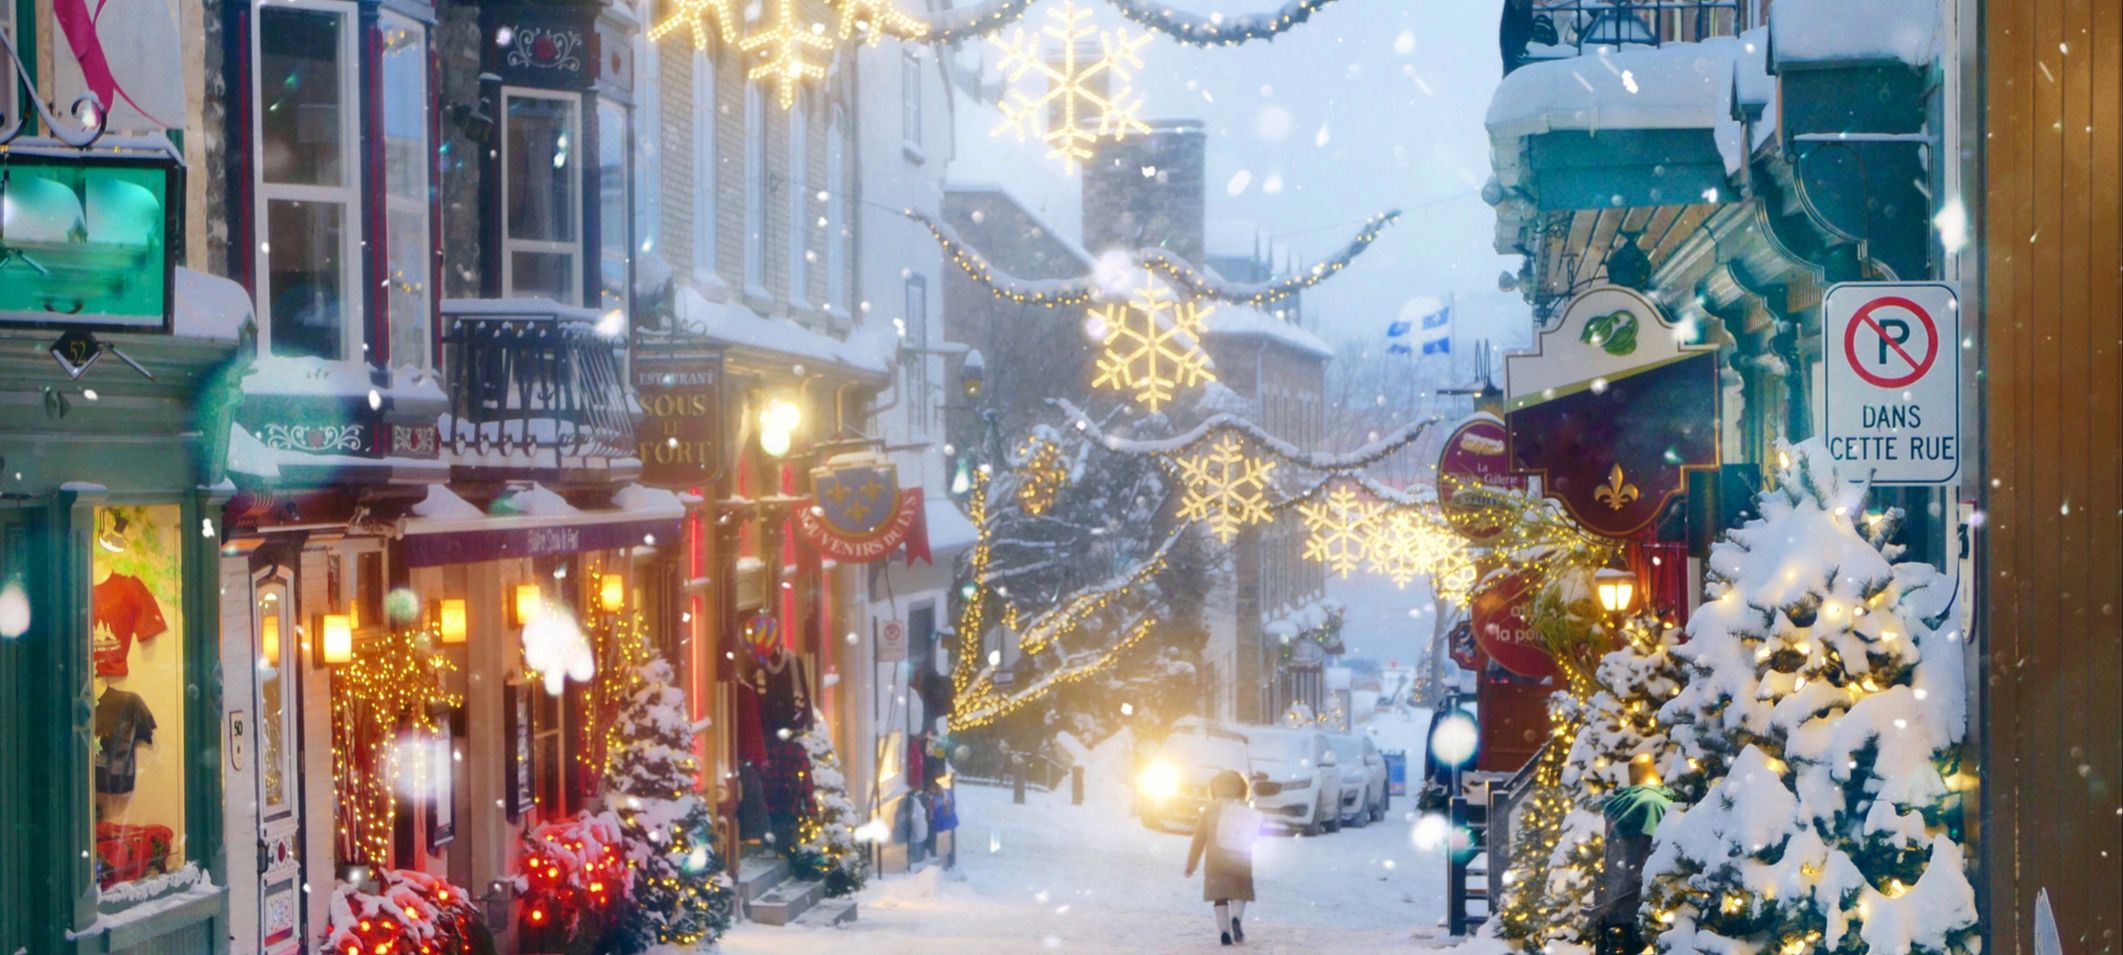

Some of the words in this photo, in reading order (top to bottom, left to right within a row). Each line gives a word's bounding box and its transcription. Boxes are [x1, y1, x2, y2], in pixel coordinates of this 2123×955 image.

[70, 341, 87, 364] 52
[639, 372, 713, 385] ESTURANT
[639, 394, 706, 417] SOUS
[1863, 405, 1921, 428] DANS
[639, 441, 712, 464] FORT
[1831, 437, 1898, 460] CETTE
[1910, 437, 1954, 460] RUE
[1477, 463, 1488, 473] La
[797, 507, 884, 557] SOUVENIRS
[883, 523, 901, 546] DU
[897, 496, 917, 527] LYS
[1496, 625, 1510, 641] la
